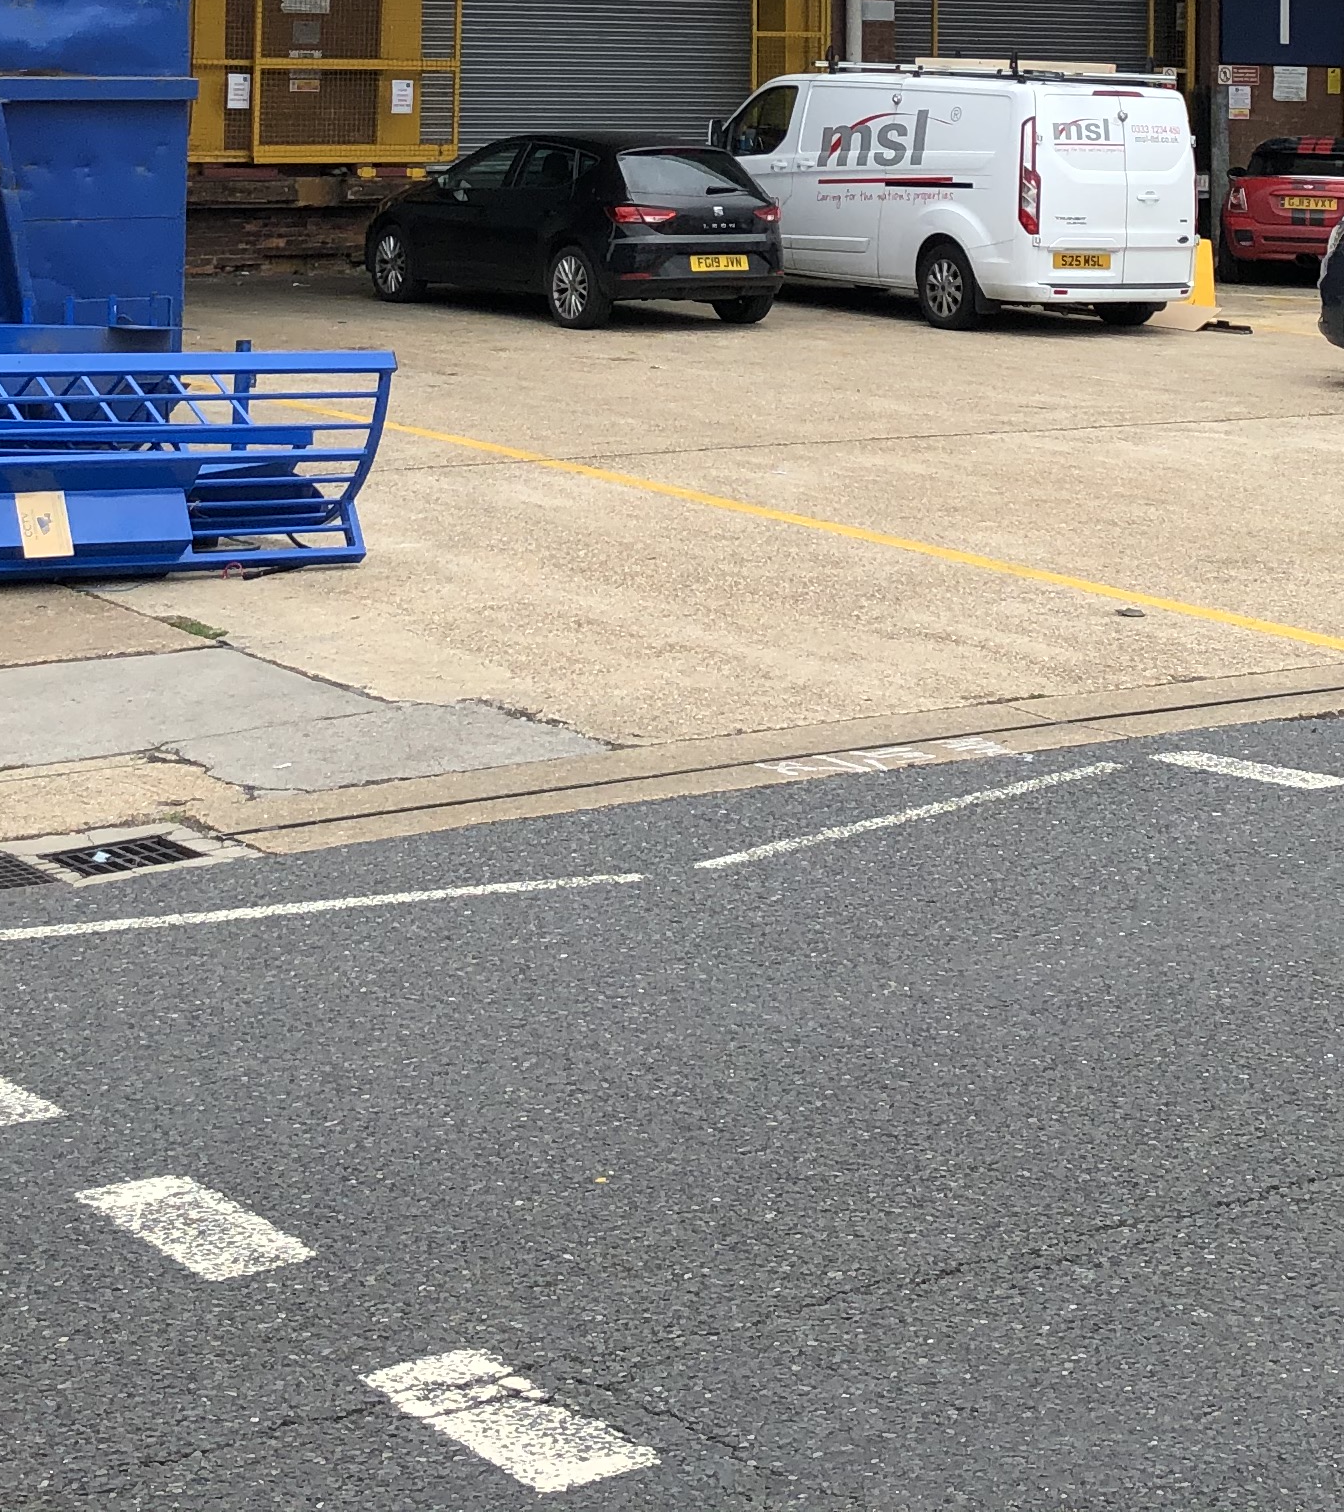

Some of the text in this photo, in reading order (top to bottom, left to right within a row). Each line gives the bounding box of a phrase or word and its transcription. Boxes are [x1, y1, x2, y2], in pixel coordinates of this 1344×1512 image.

[816, 108, 930, 167] msl
[1052, 118, 1111, 142] msl
[816, 188, 954, 209] Caring for the nation's properties
[1313, 199, 1334, 209] VXT
[723, 256, 743, 268] JVN
[1061, 255, 1103, 268] S25 MSL
[21, 511, 34, 538] CCTV
